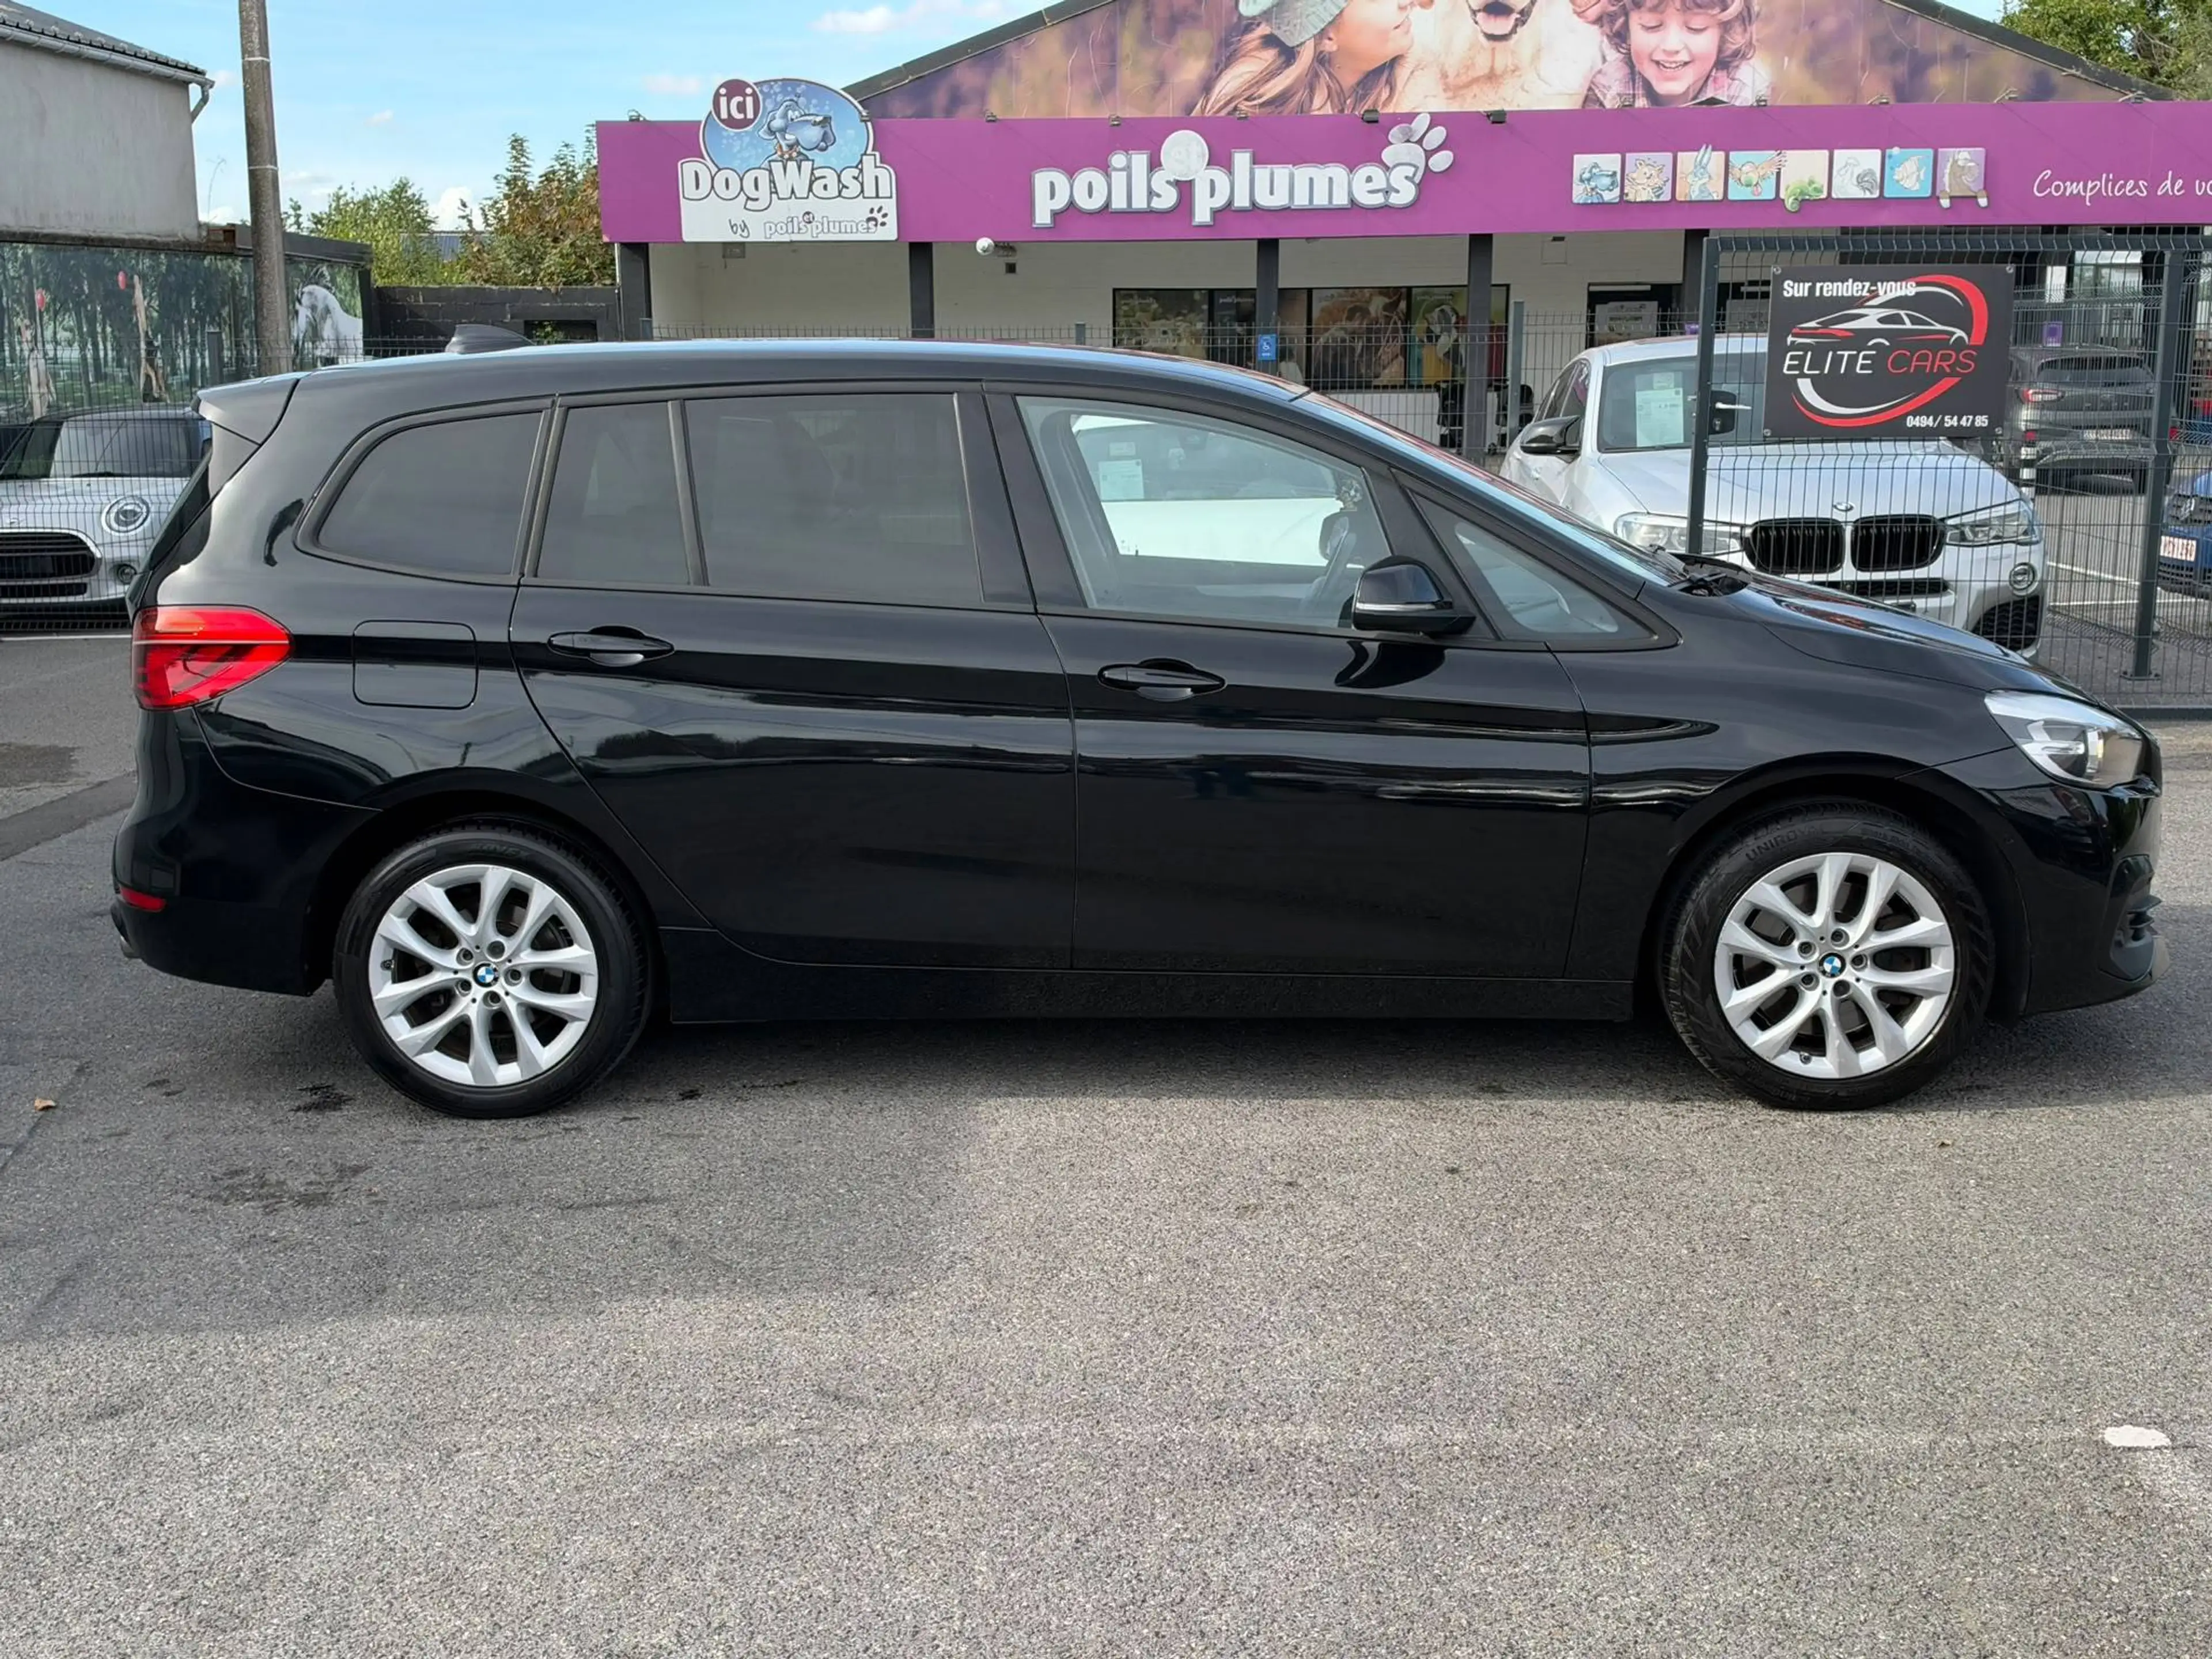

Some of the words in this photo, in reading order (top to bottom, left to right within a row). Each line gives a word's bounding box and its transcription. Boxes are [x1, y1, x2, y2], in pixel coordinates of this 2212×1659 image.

[718, 87, 755, 119] ici
[681, 153, 893, 211] DogWash
[1032, 150, 1180, 228] poils
[1192, 149, 1421, 226] plumes
[2033, 169, 2148, 206] Complices
[2157, 171, 2185, 196] de
[729, 219, 751, 238] by
[764, 217, 809, 238] poils
[811, 216, 878, 238] plumes
[1783, 280, 1812, 297] Sur
[1816, 278, 1916, 297] rendez-vous
[1783, 351, 1877, 374] ELITE
[1887, 350, 1978, 374] CARS
[1906, 415, 1942, 427] 0494/
[1944, 415, 1958, 427] 54
[1960, 415, 1973, 427] 47
[1975, 415, 1989, 427] 85
